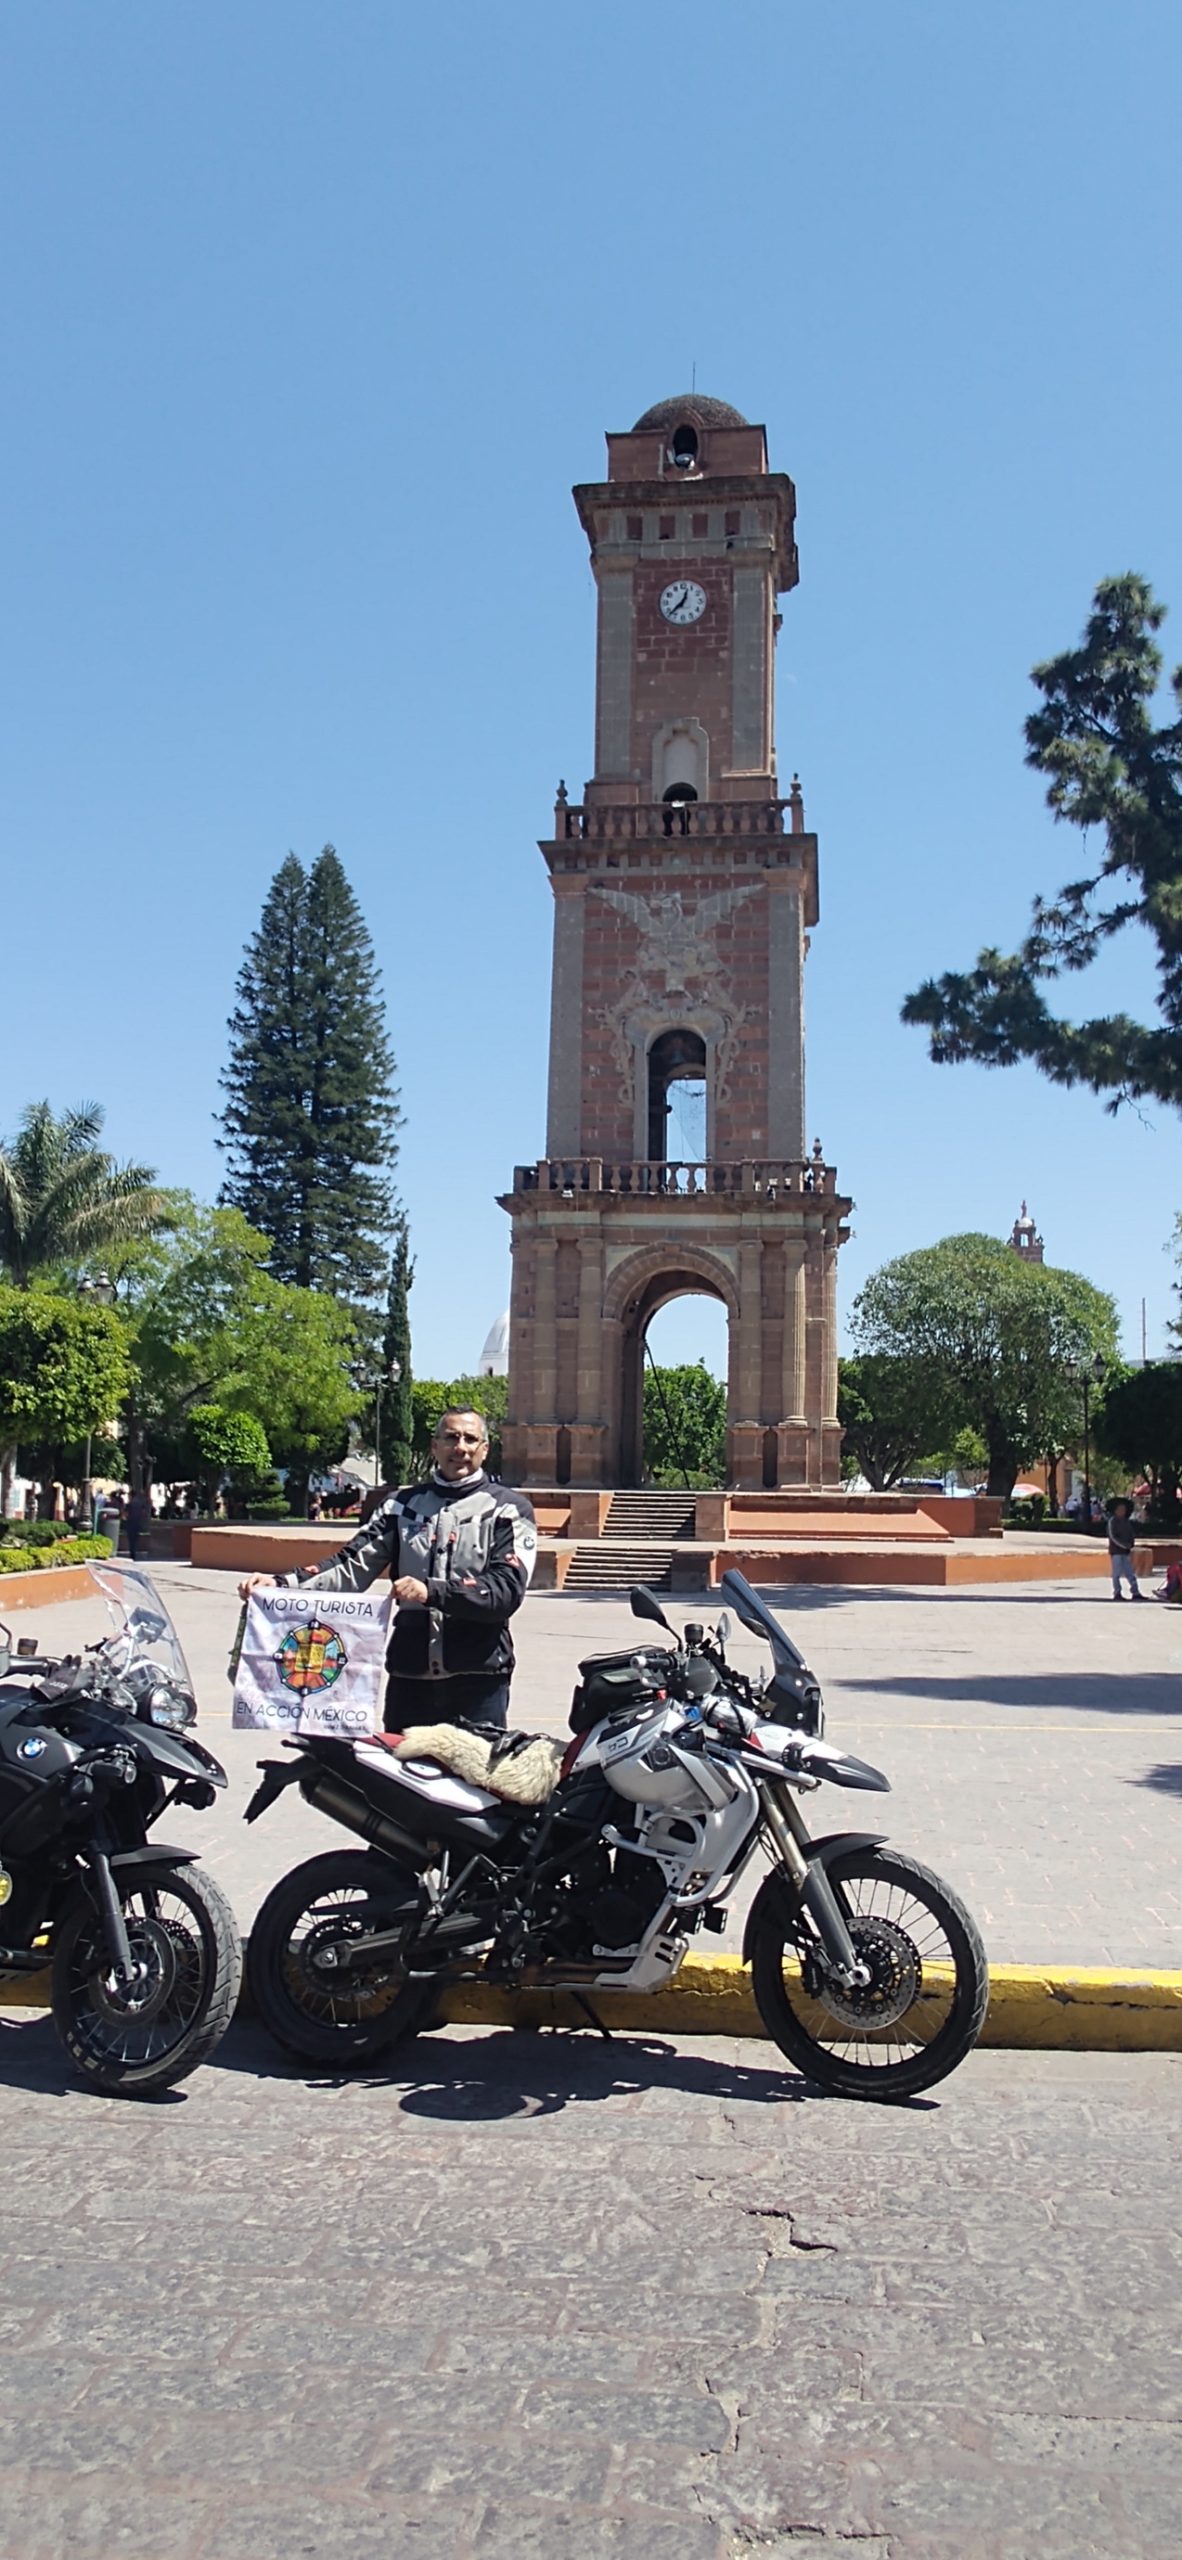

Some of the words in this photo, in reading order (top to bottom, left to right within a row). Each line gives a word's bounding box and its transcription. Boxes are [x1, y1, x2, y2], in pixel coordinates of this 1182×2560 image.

[262, 1598, 309, 1612] MOTO
[314, 1599, 373, 1617] TURISTA
[237, 1701, 253, 1715] EN
[256, 1703, 311, 1720] ACCIÓN
[313, 1706, 367, 1722] MÉXICO
